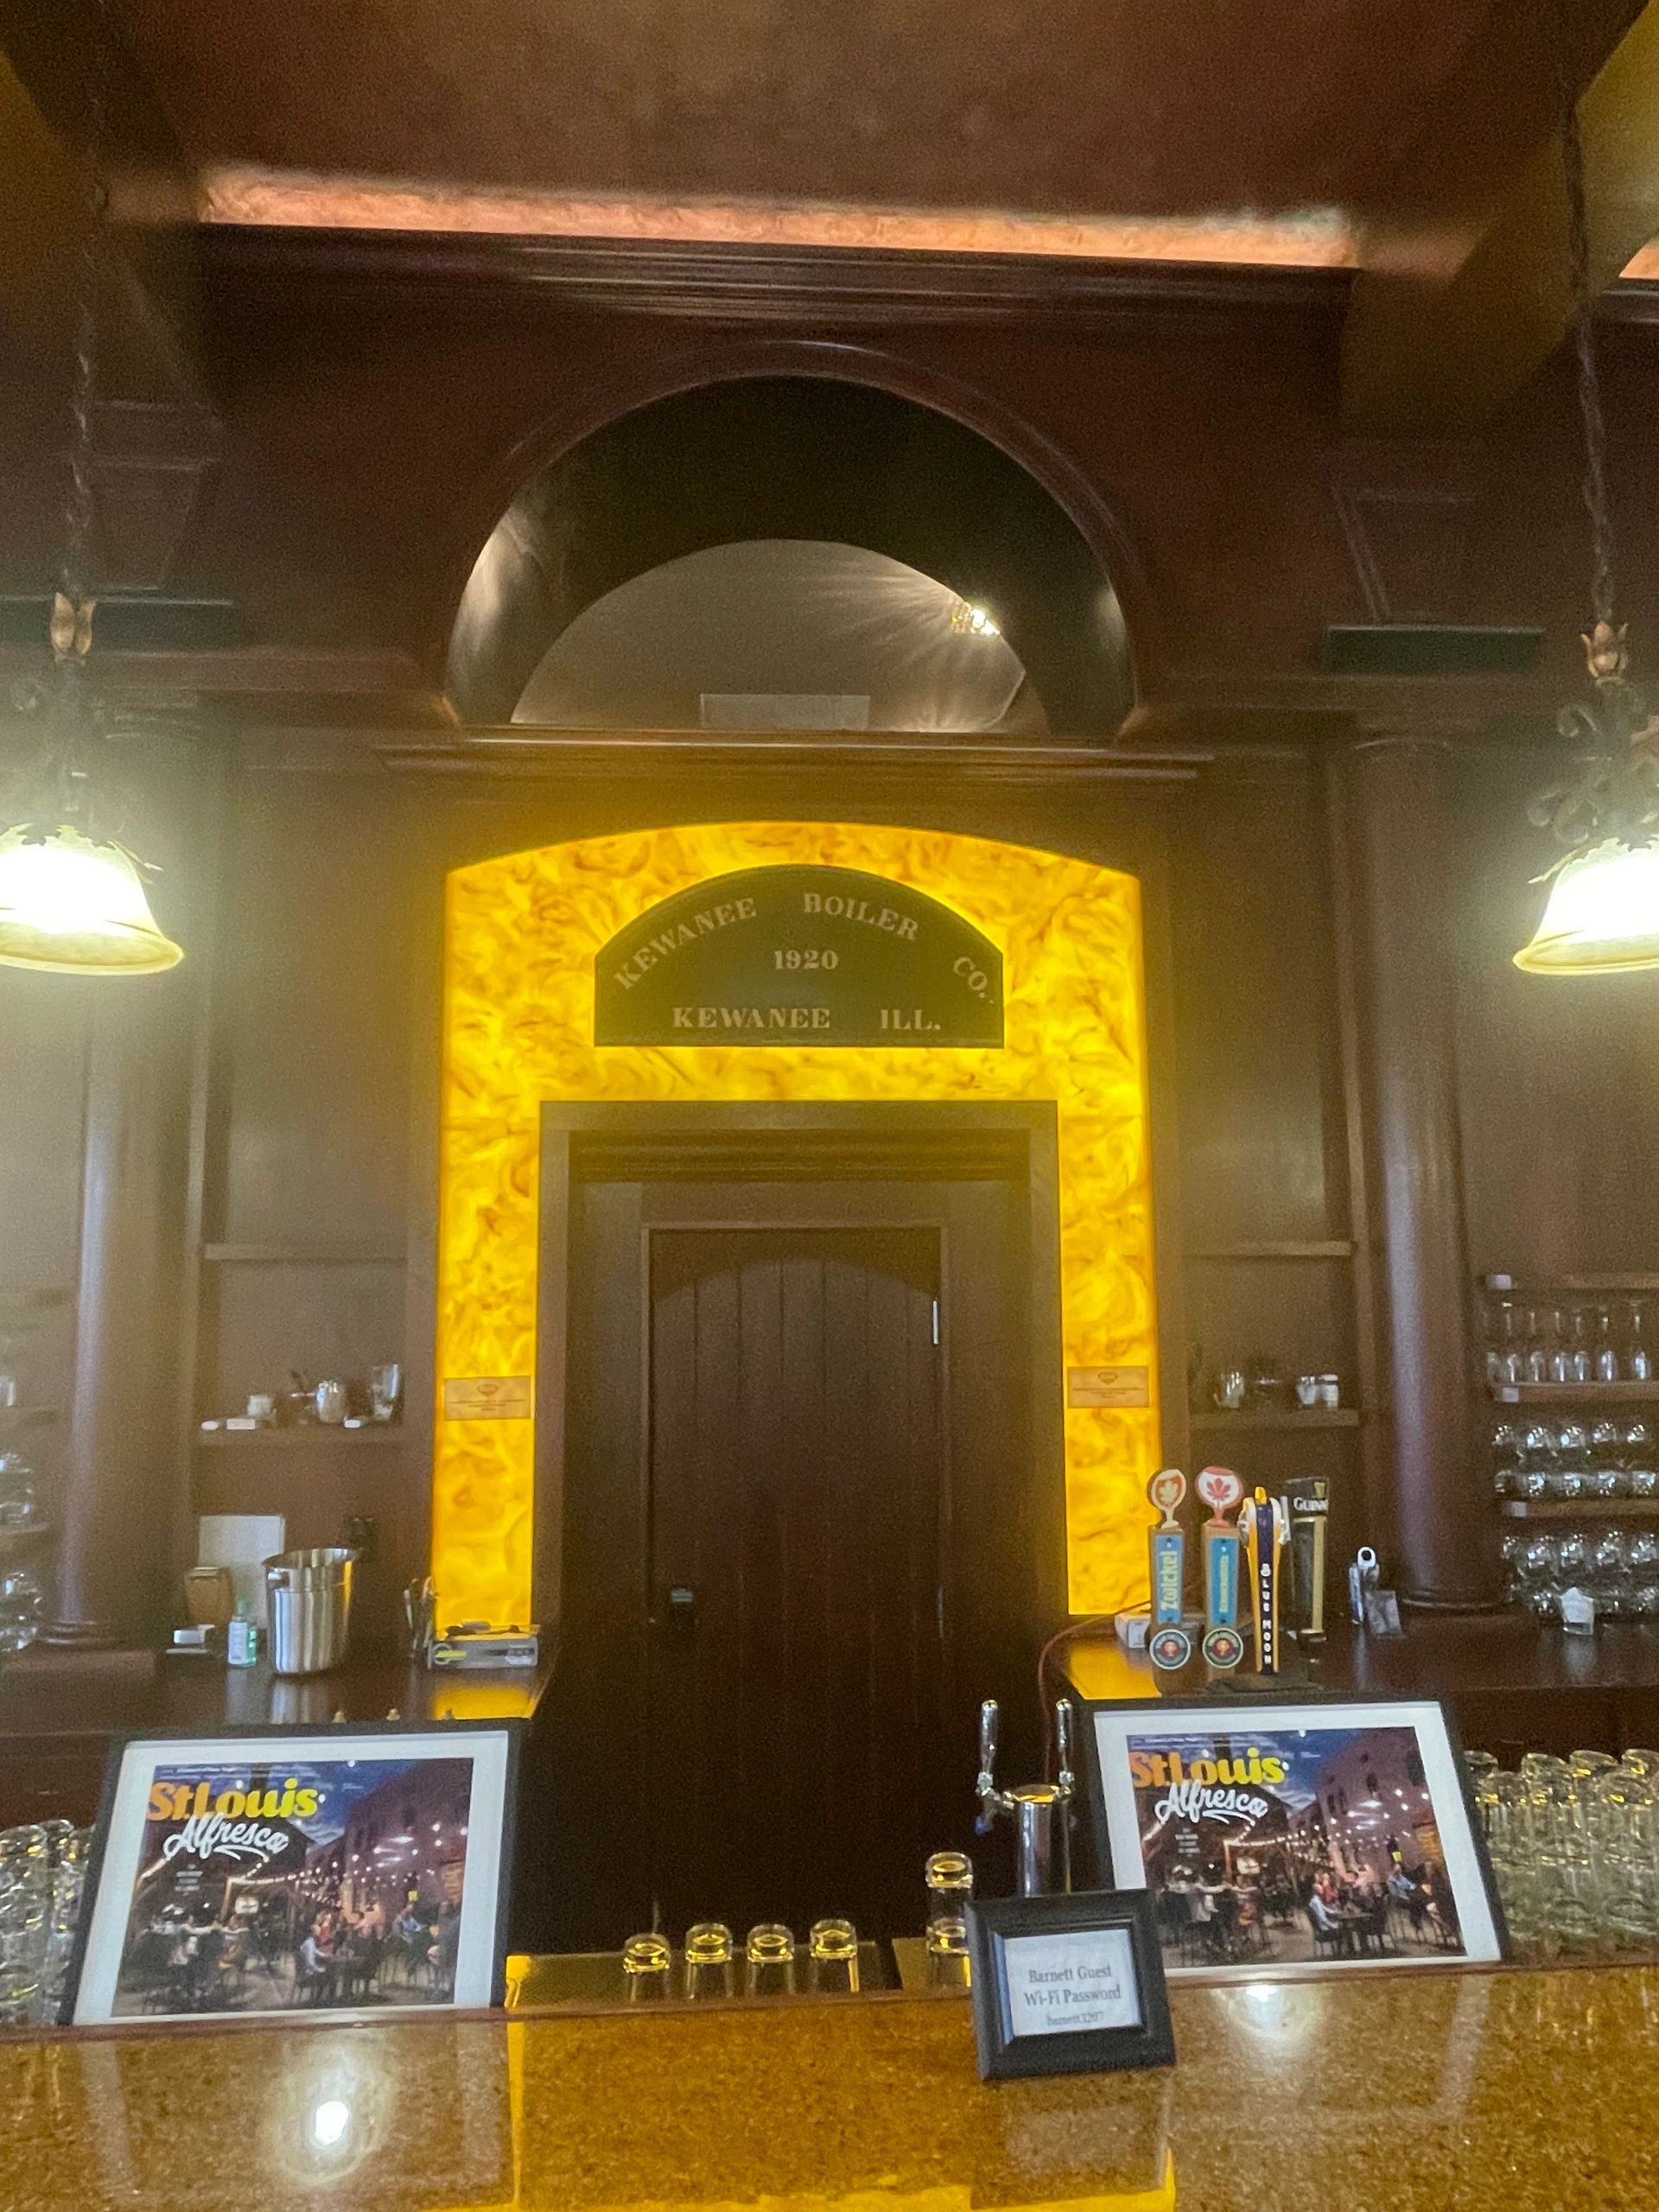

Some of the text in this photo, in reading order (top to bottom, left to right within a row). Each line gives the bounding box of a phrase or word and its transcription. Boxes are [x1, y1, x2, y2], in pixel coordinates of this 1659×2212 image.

[613, 896, 757, 989] KEWANEE
[803, 892, 919, 941] BOILER
[773, 950, 839, 969] 1920
[672, 1007, 942, 1030] KEWANEE ILL.
[1261, 1562, 1272, 1665] BLUE MOON
[1154, 1779, 1269, 1825] Alfresco
[162, 1811, 289, 1861] Alfresco
[1028, 1964, 1112, 1983] Barnett Guest
[1024, 1984, 1122, 2005] Wi-Fi Password
